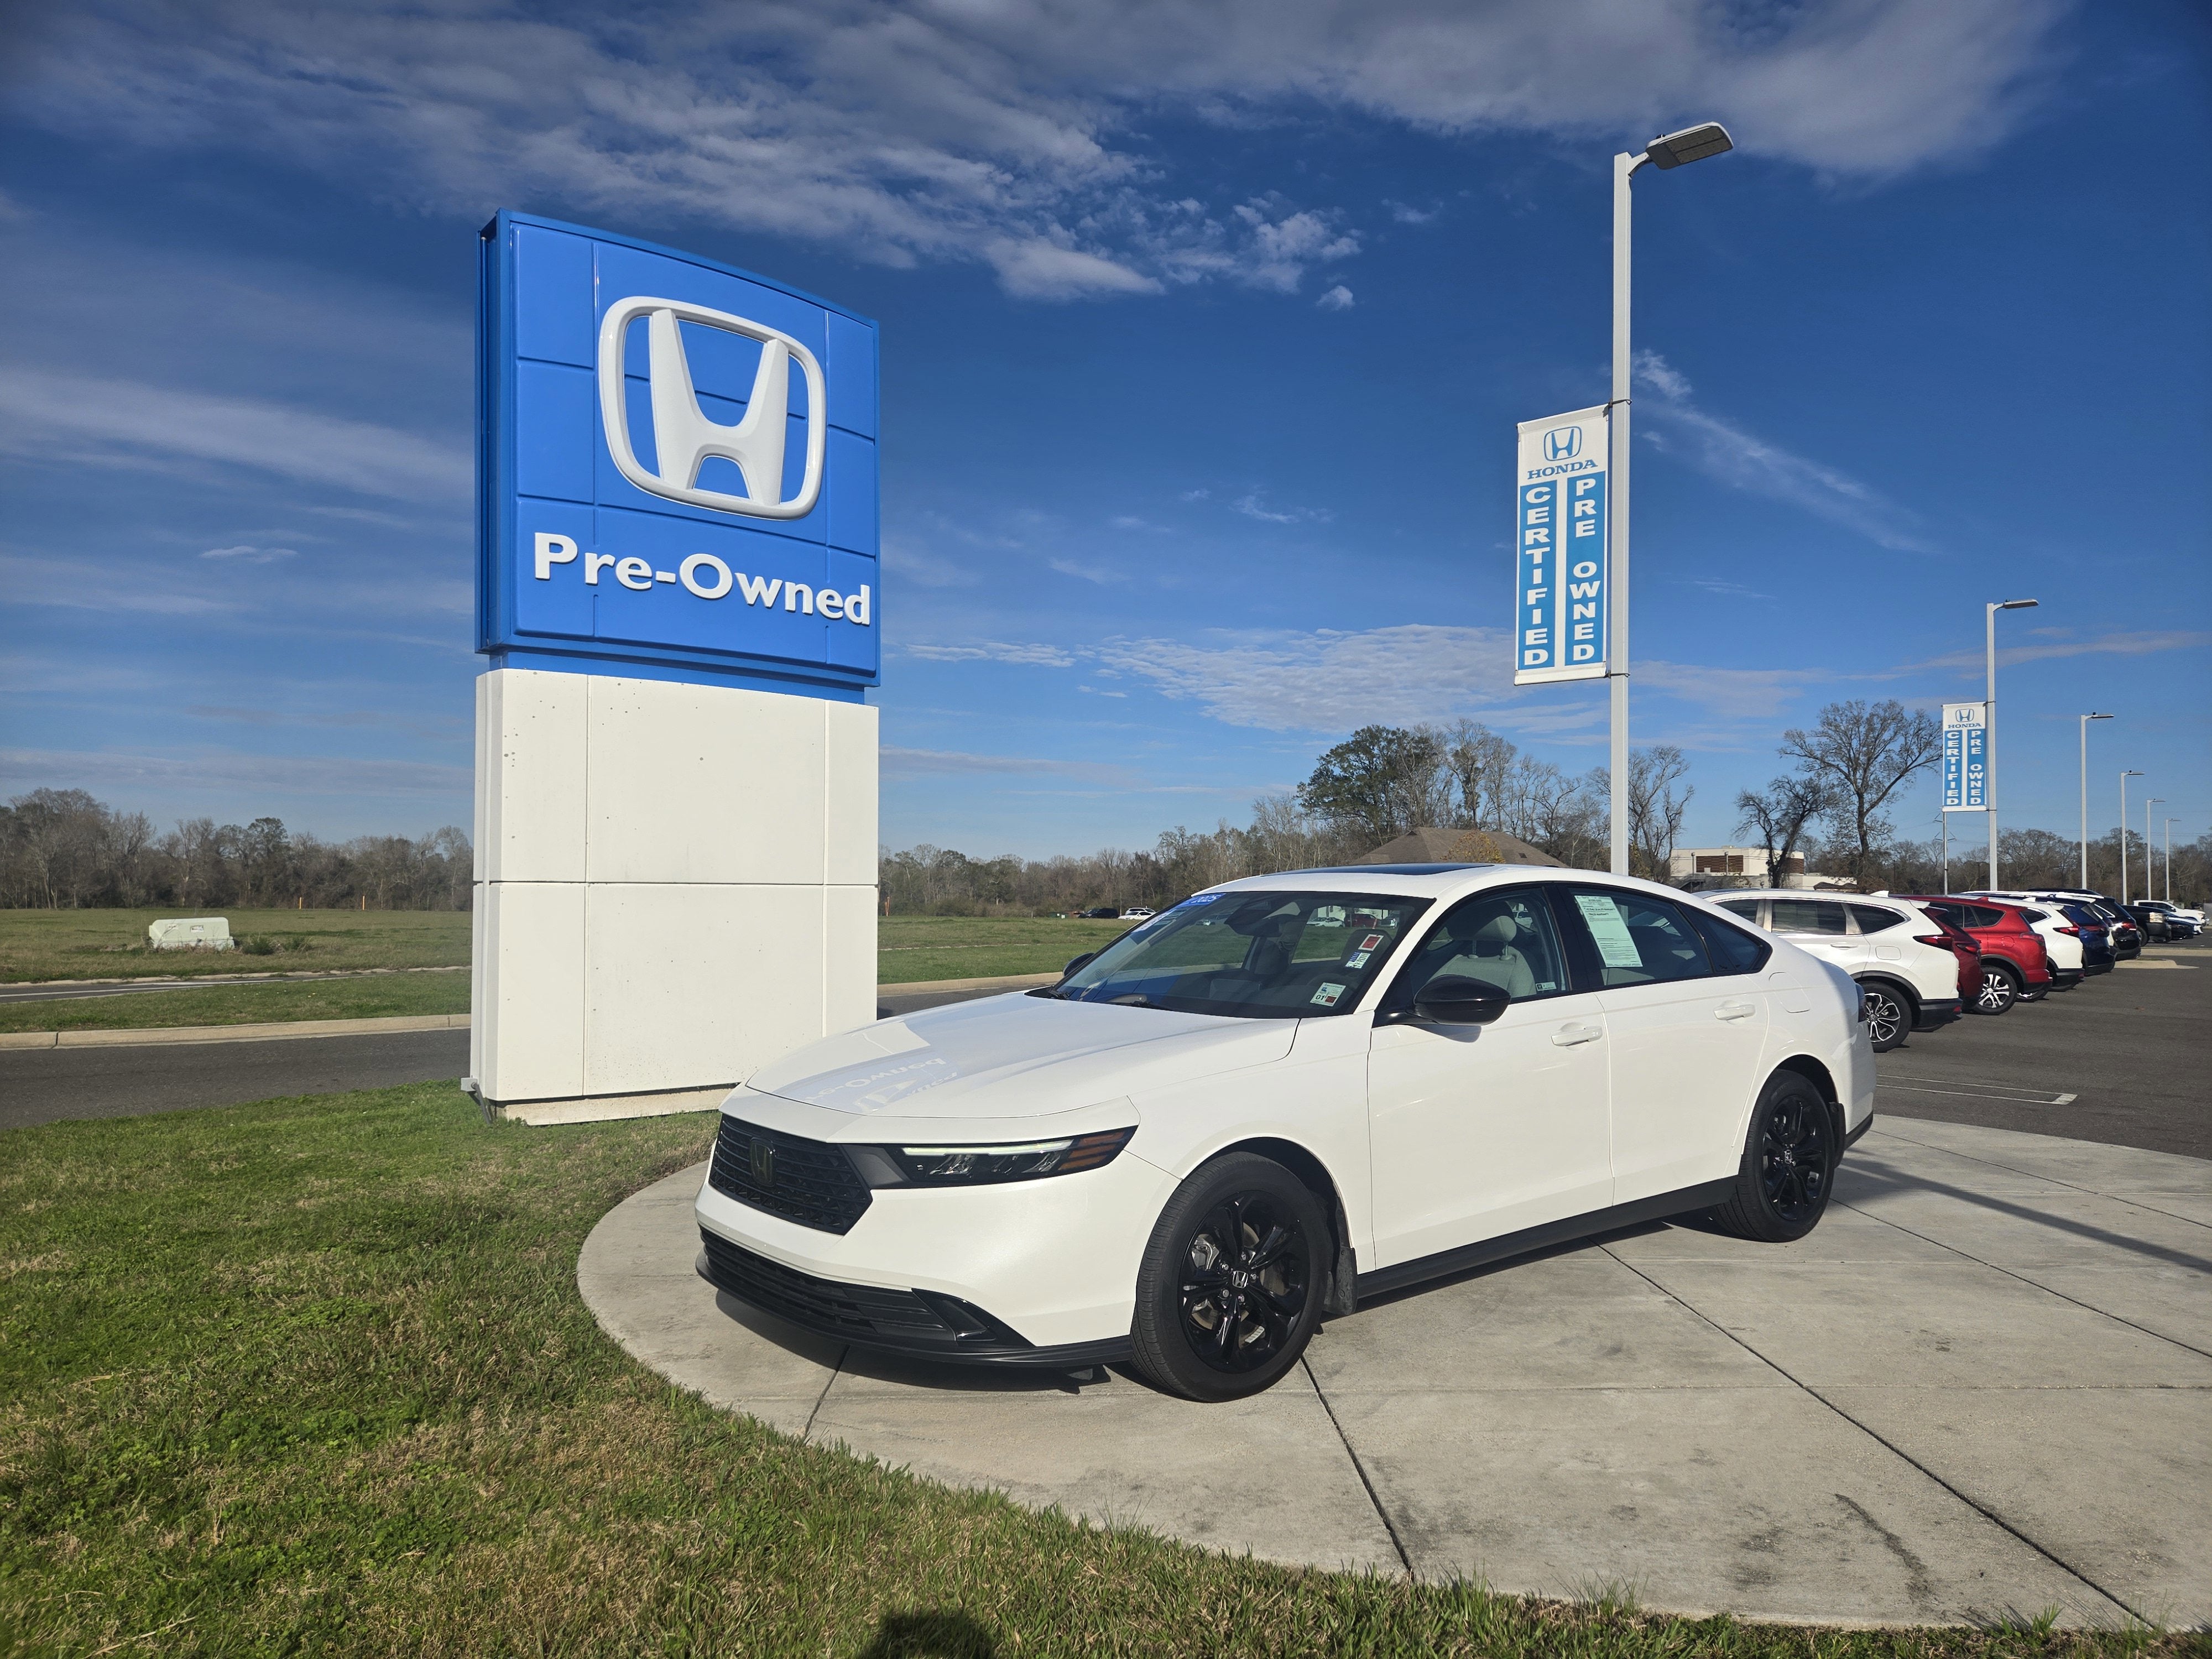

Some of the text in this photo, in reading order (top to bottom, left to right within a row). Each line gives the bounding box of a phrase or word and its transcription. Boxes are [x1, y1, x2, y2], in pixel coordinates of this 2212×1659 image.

[1527, 460, 1598, 479] HONDA
[534, 532, 870, 625] Pre-Owned
[1524, 486, 1552, 666] CERTIFIED
[1569, 478, 1600, 661] PRE OWNED
[1946, 732, 1960, 806] CERTIFIED
[1968, 731, 1984, 805] PRE OWNED
